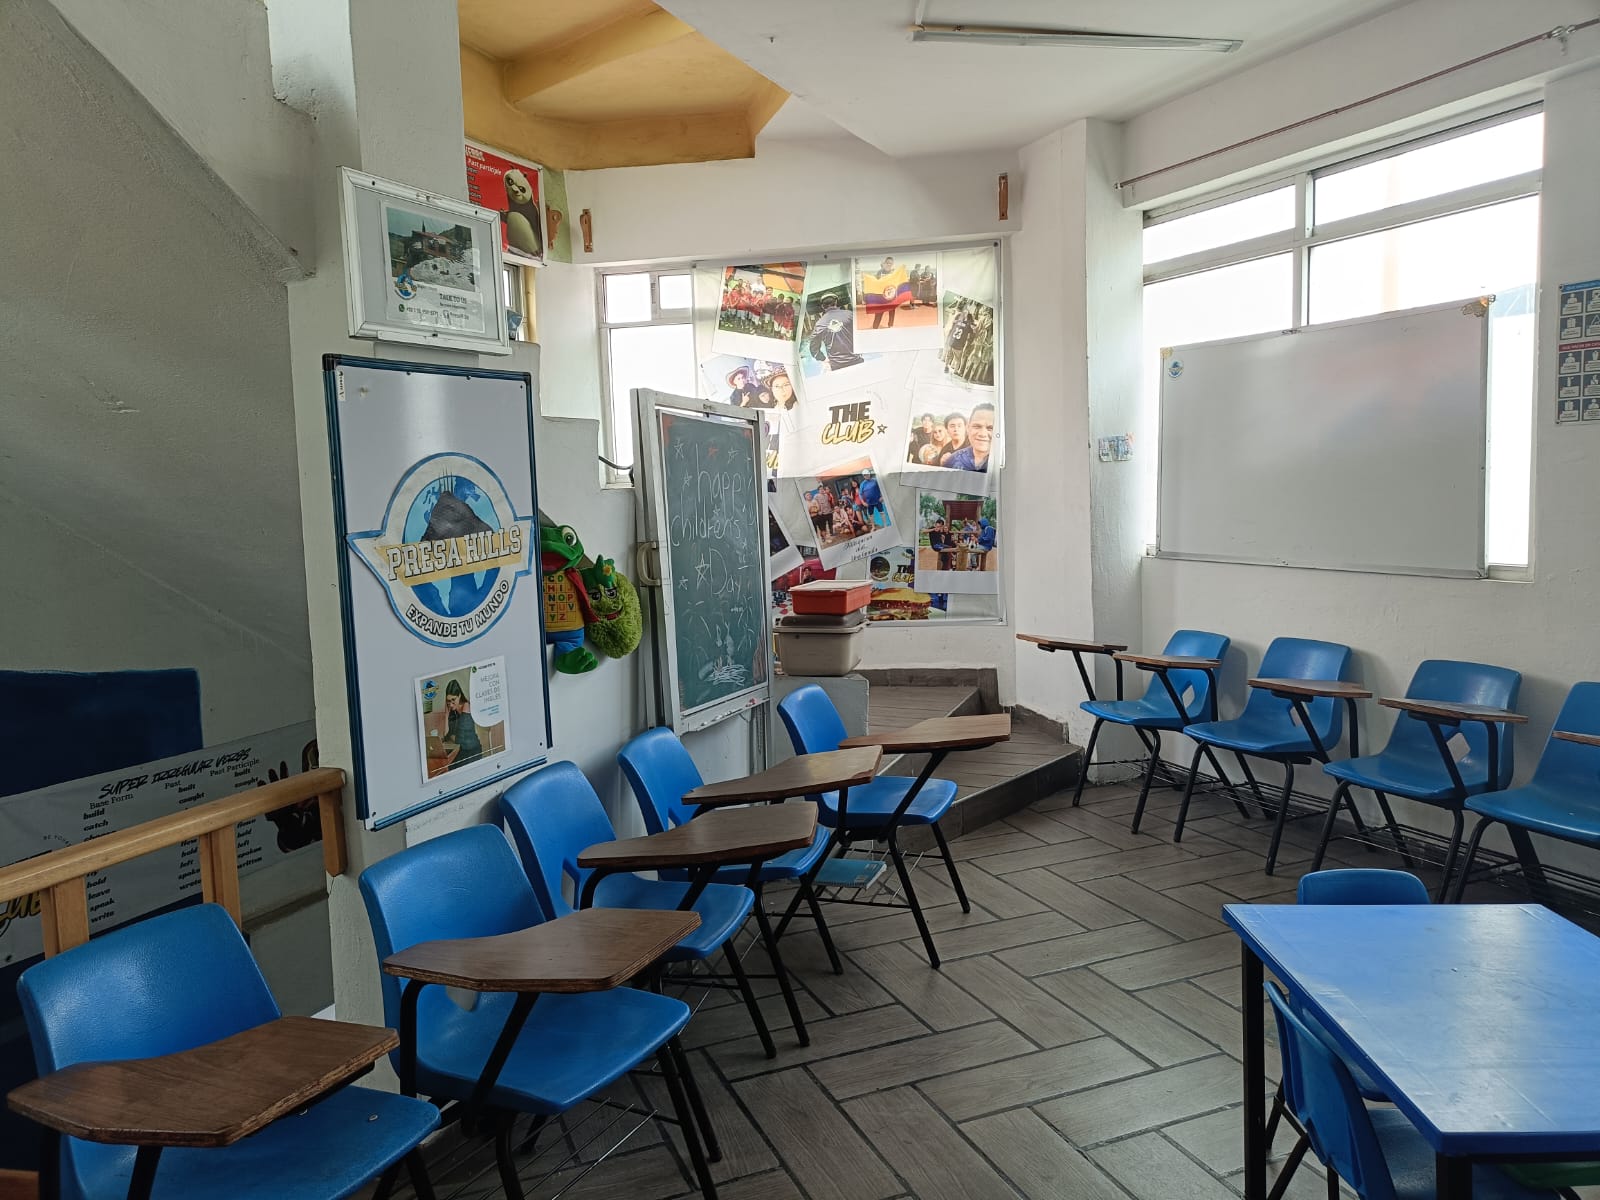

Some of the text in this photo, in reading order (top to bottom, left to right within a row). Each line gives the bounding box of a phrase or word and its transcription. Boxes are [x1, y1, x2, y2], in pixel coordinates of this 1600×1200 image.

[828, 400, 872, 425] THE
[821, 419, 875, 445] CLUB
[695, 443, 752, 519] happy
[386, 524, 522, 581] PRESA HILLS
[708, 547, 741, 597] Day
[405, 579, 510, 637] EXPANDE TU MUNDO
[98, 747, 252, 799] SUPER IRREGULAR VERBS
[209, 758, 260, 777] Past Participle
[164, 780, 181, 790] Past
[89, 793, 134, 810] Base Form
[83, 808, 105, 820] build
[83, 819, 109, 832] catch
[86, 876, 107, 889] hold
[87, 888, 111, 901] leave
[90, 897, 115, 912] speak
[90, 910, 115, 923] write
